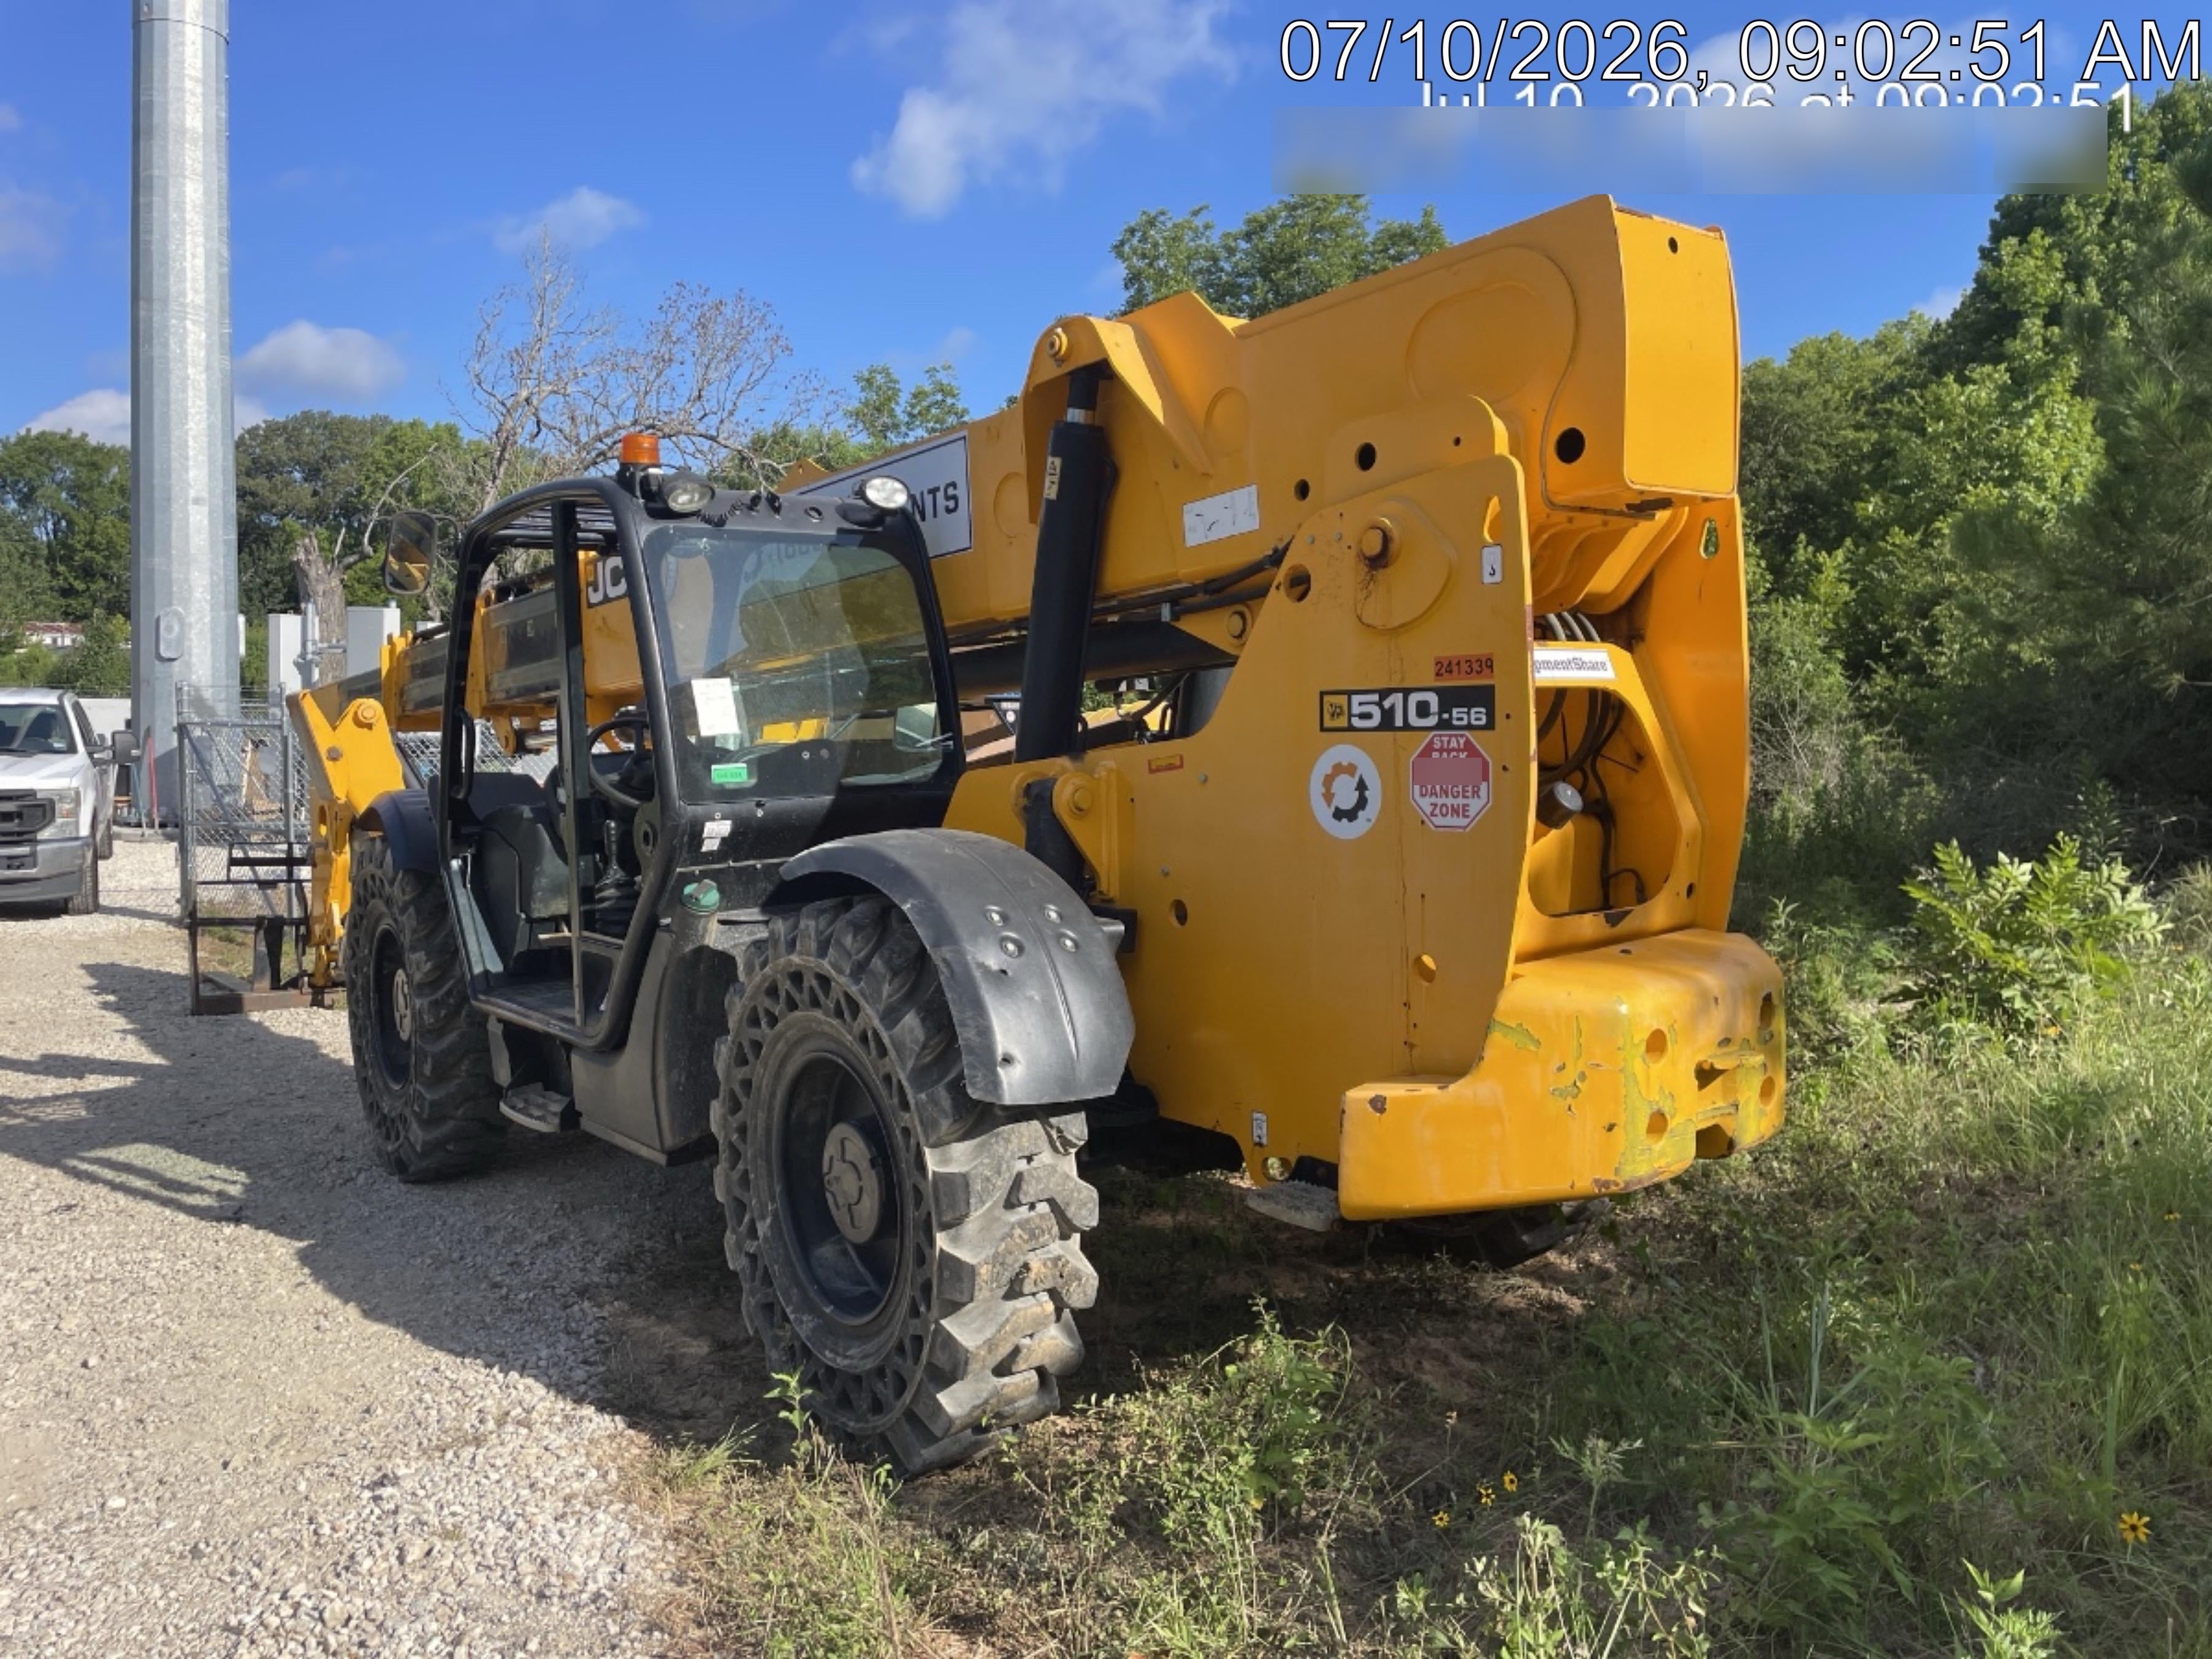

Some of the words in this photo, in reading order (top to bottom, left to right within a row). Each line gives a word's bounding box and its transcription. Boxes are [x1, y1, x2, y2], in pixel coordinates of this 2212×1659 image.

[910, 480, 959, 522] NTS
[587, 556, 627, 603] JC
[1435, 657, 1494, 677] 241339
[1534, 657, 1609, 673] pmentShare
[1351, 691, 1487, 728] 510-56
[1433, 737, 1467, 749] STAY
[1419, 785, 1481, 799] DANGER
[1430, 803, 1470, 818] ZONE
